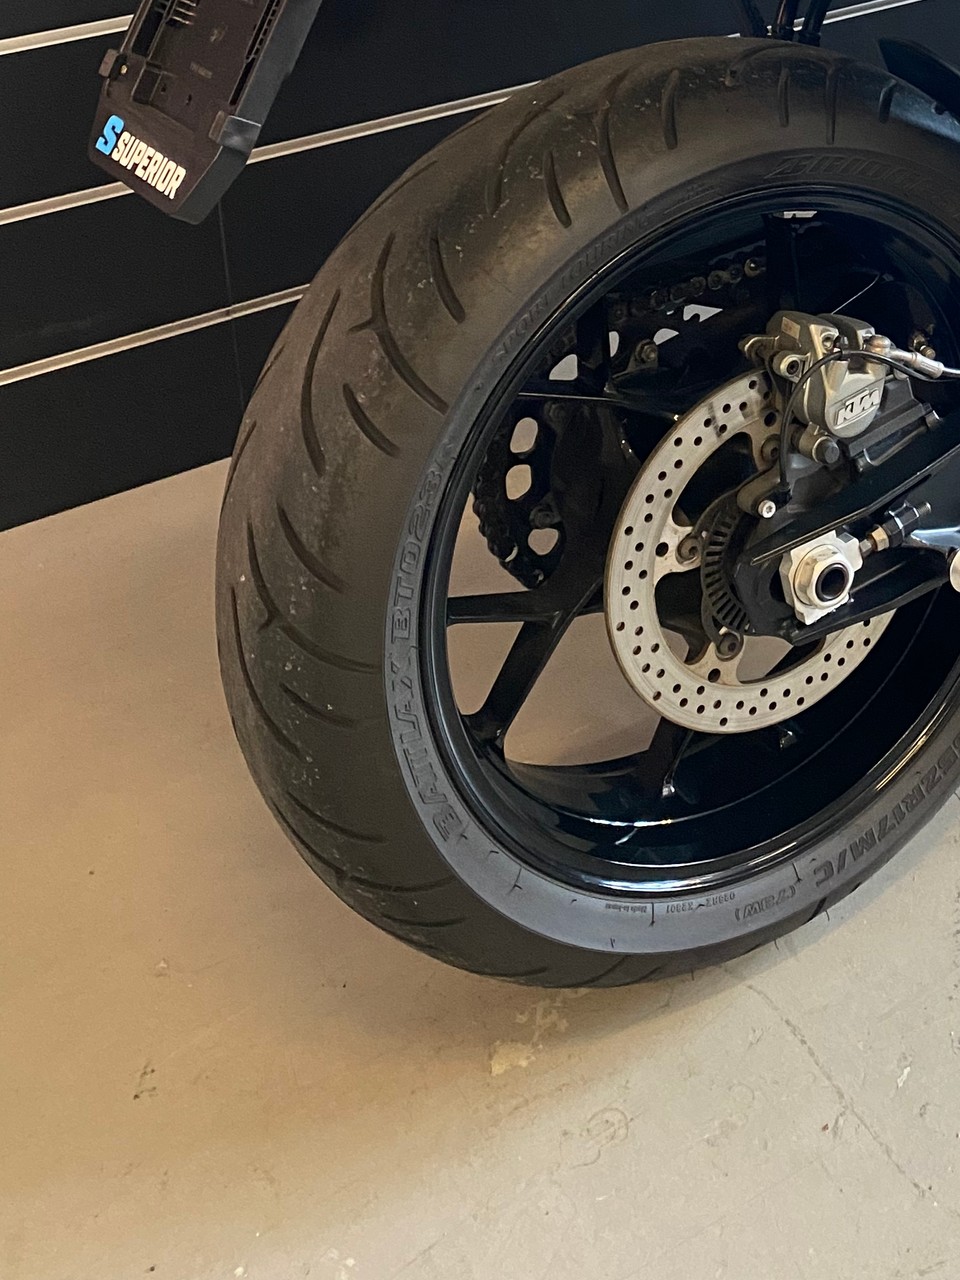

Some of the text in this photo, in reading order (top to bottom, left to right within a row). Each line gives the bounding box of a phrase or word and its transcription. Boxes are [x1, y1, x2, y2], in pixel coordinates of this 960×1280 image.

[112, 131, 186, 200] SUPERIOR
[836, 389, 880, 426] KTM
[390, 656, 464, 841] BATTLAX
